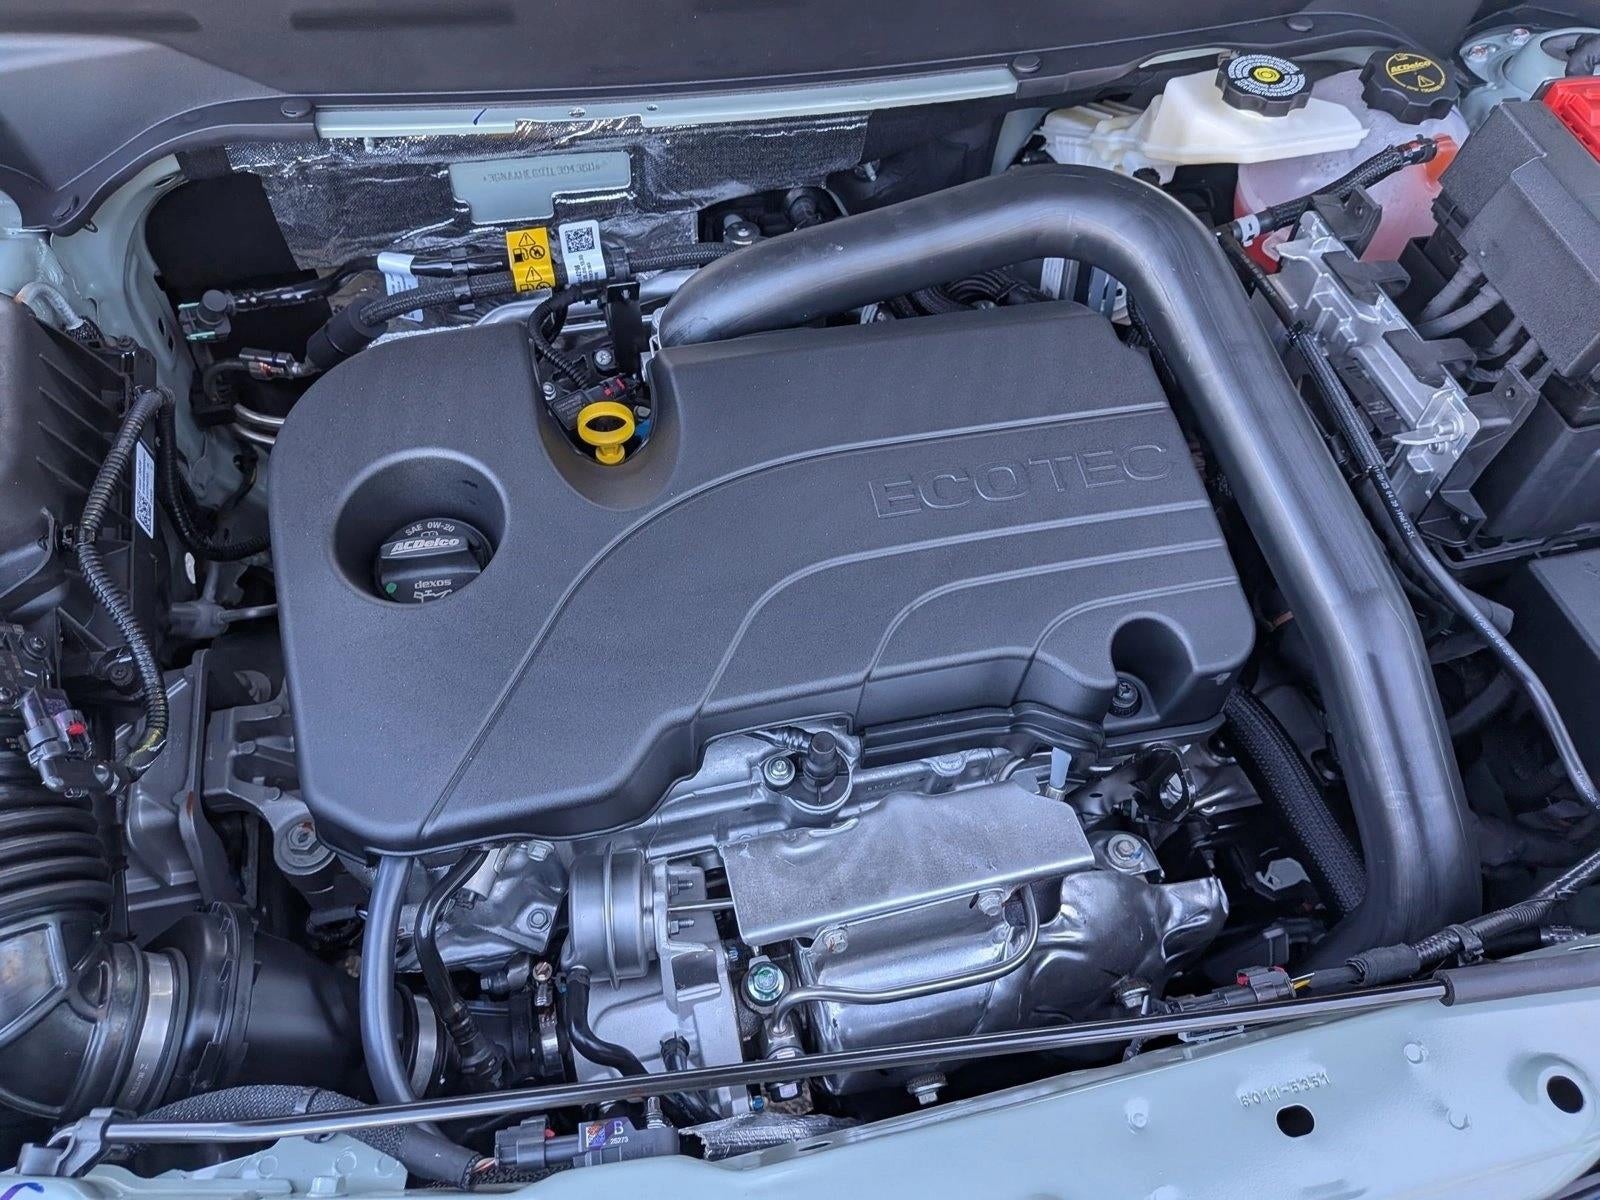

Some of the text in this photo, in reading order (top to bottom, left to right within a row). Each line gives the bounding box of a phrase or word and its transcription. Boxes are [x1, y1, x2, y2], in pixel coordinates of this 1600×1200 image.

[868, 444, 1172, 519] ECOTEC
[405, 521, 456, 536] SAE 0W-20
[390, 537, 460, 555] ACDelco
[414, 579, 452, 590] dexos
[613, 1120, 624, 1136] B
